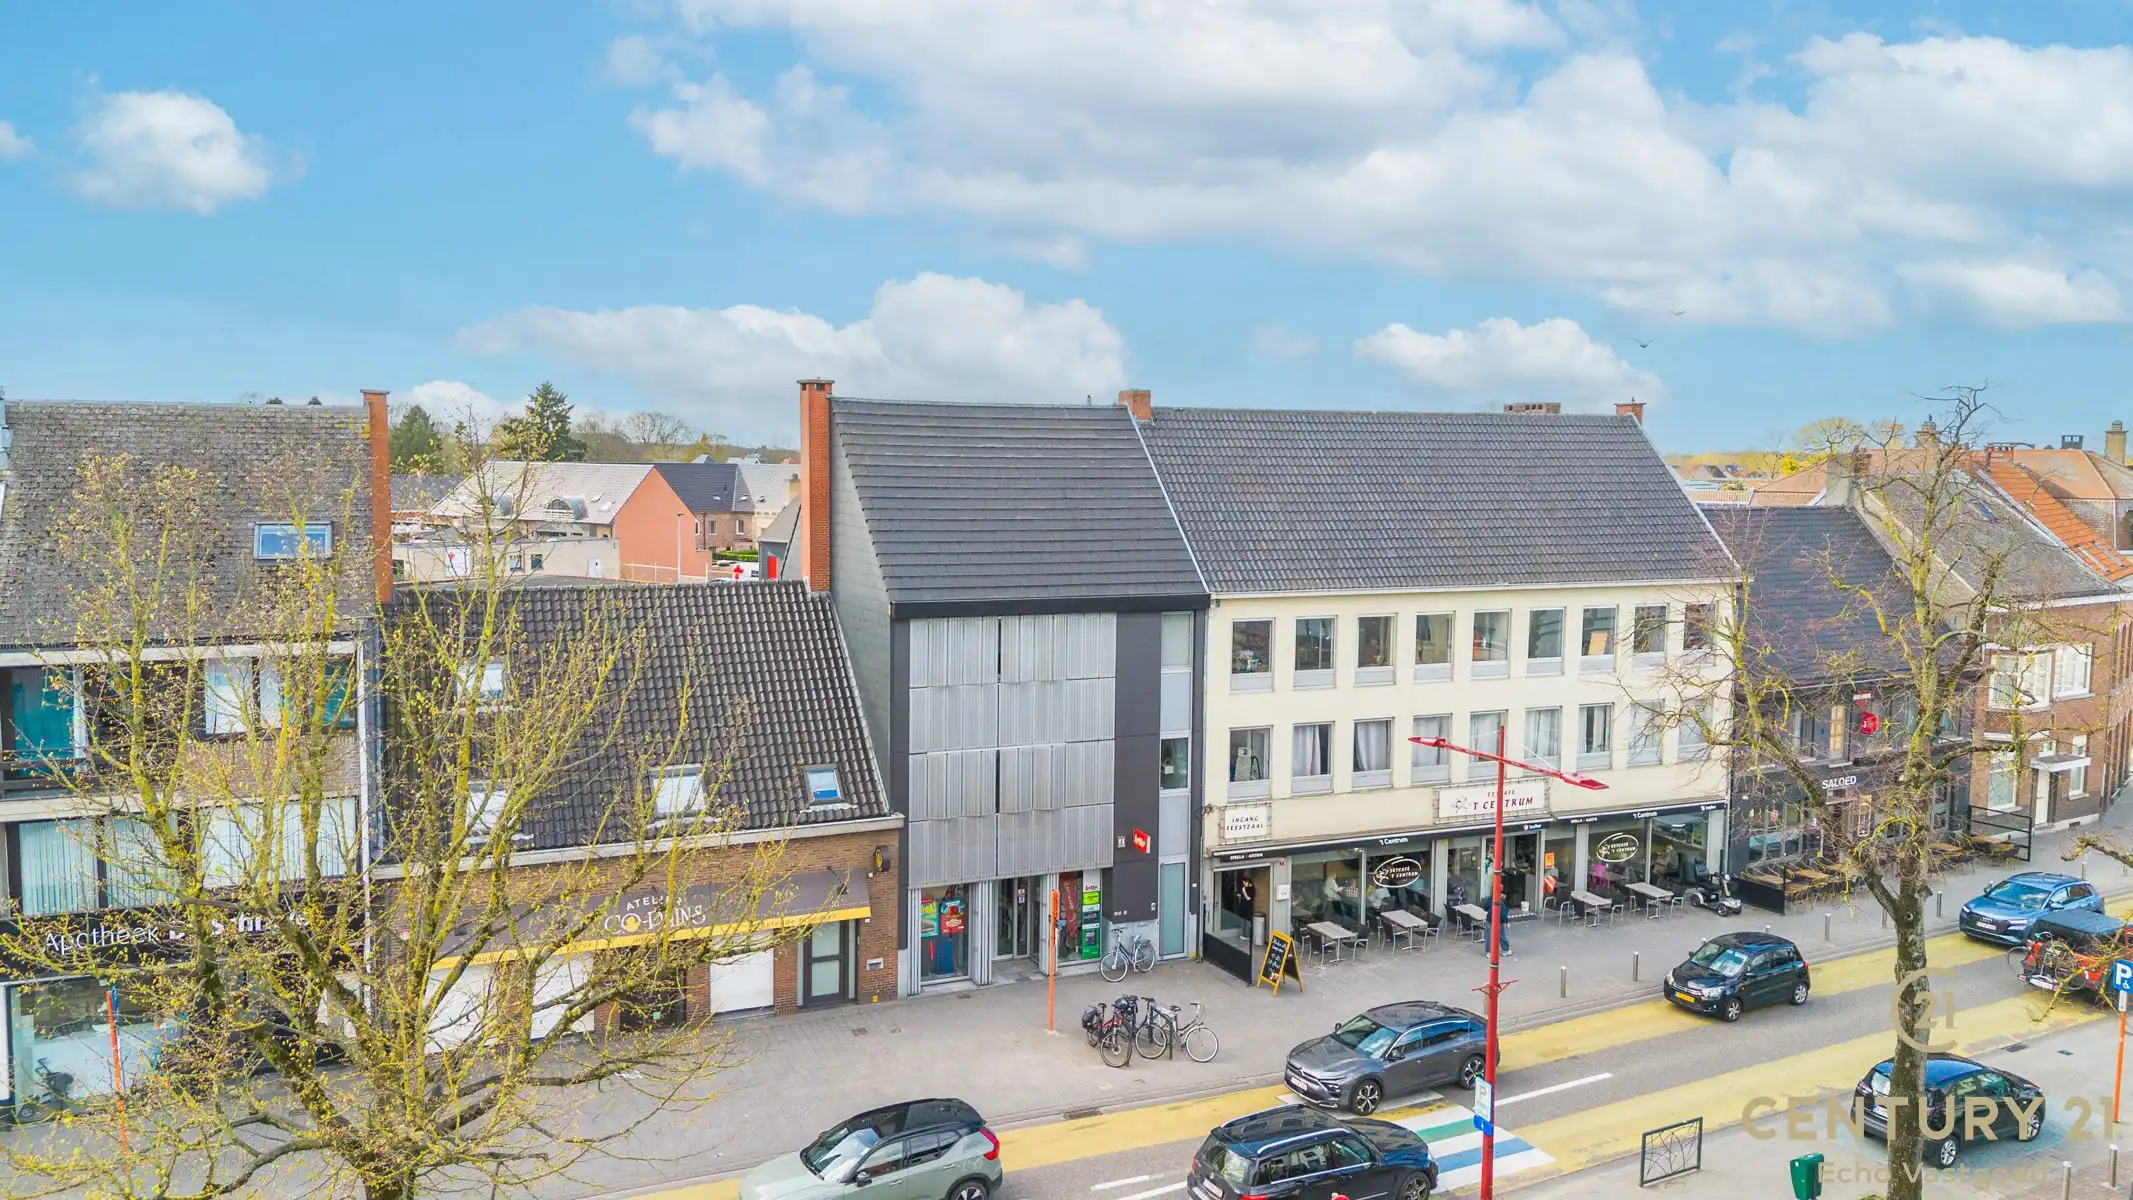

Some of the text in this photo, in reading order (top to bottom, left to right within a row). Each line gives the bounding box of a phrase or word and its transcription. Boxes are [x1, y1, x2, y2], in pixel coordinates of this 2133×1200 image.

[1821, 775, 1857, 790] SALOED
[1483, 797, 1533, 810] CETRUM
[1226, 823, 1264, 831] FEESTZAAL
[1384, 837, 1409, 845] Centrum
[45, 924, 160, 956] Apotheek
[2116, 962, 2132, 985] P
